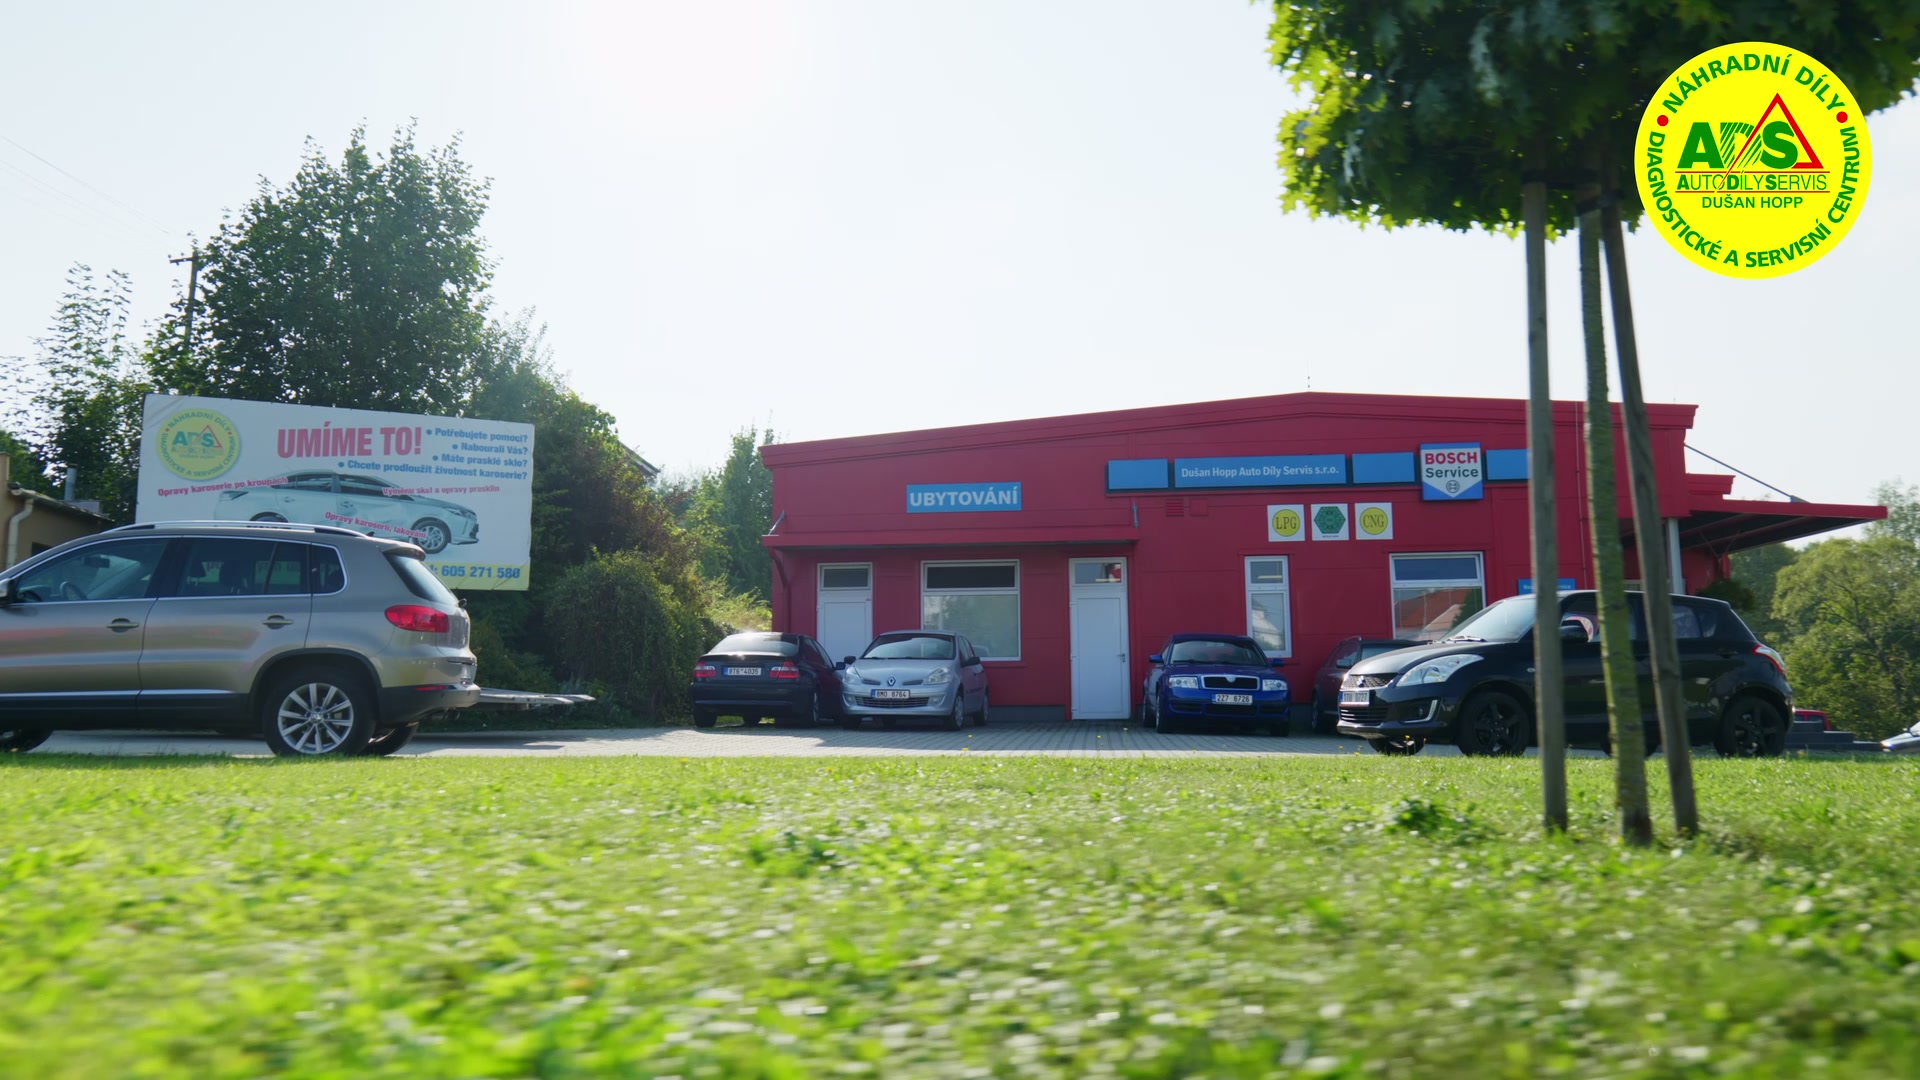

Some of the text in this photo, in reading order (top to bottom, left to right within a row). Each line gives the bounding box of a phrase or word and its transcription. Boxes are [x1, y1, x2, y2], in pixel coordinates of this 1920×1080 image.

[277, 421, 422, 458] UMÍME TO!
[435, 428, 487, 440] Potřebujete
[461, 442, 528, 455] Nabourali Vás?
[441, 453, 528, 467] Máte prasklé sklo?
[1425, 451, 1478, 465] BOSCH
[347, 460, 528, 480] Chcete prodloužit životnost karoserie?
[1181, 467, 1210, 478] Dušan
[1212, 467, 1237, 479] Hopp
[1239, 467, 1261, 477] Auto
[1283, 465, 1313, 476] Servis
[1315, 465, 1339, 475] s.r.o.
[1425, 466, 1479, 478] Service
[158, 477, 288, 497] Opravy karoserie po kroupách
[441, 487, 467, 495] opravy
[469, 485, 500, 494] prasklin
[909, 486, 1018, 507] UBYTOVÁNÍ
[325, 511, 353, 524] Opravy
[393, 526, 427, 538] lakování
[1275, 516, 1297, 530] LPG
[1362, 514, 1385, 528] CNG
[441, 565, 466, 577] 605
[470, 566, 492, 578] 271
[497, 567, 520, 579] 580
